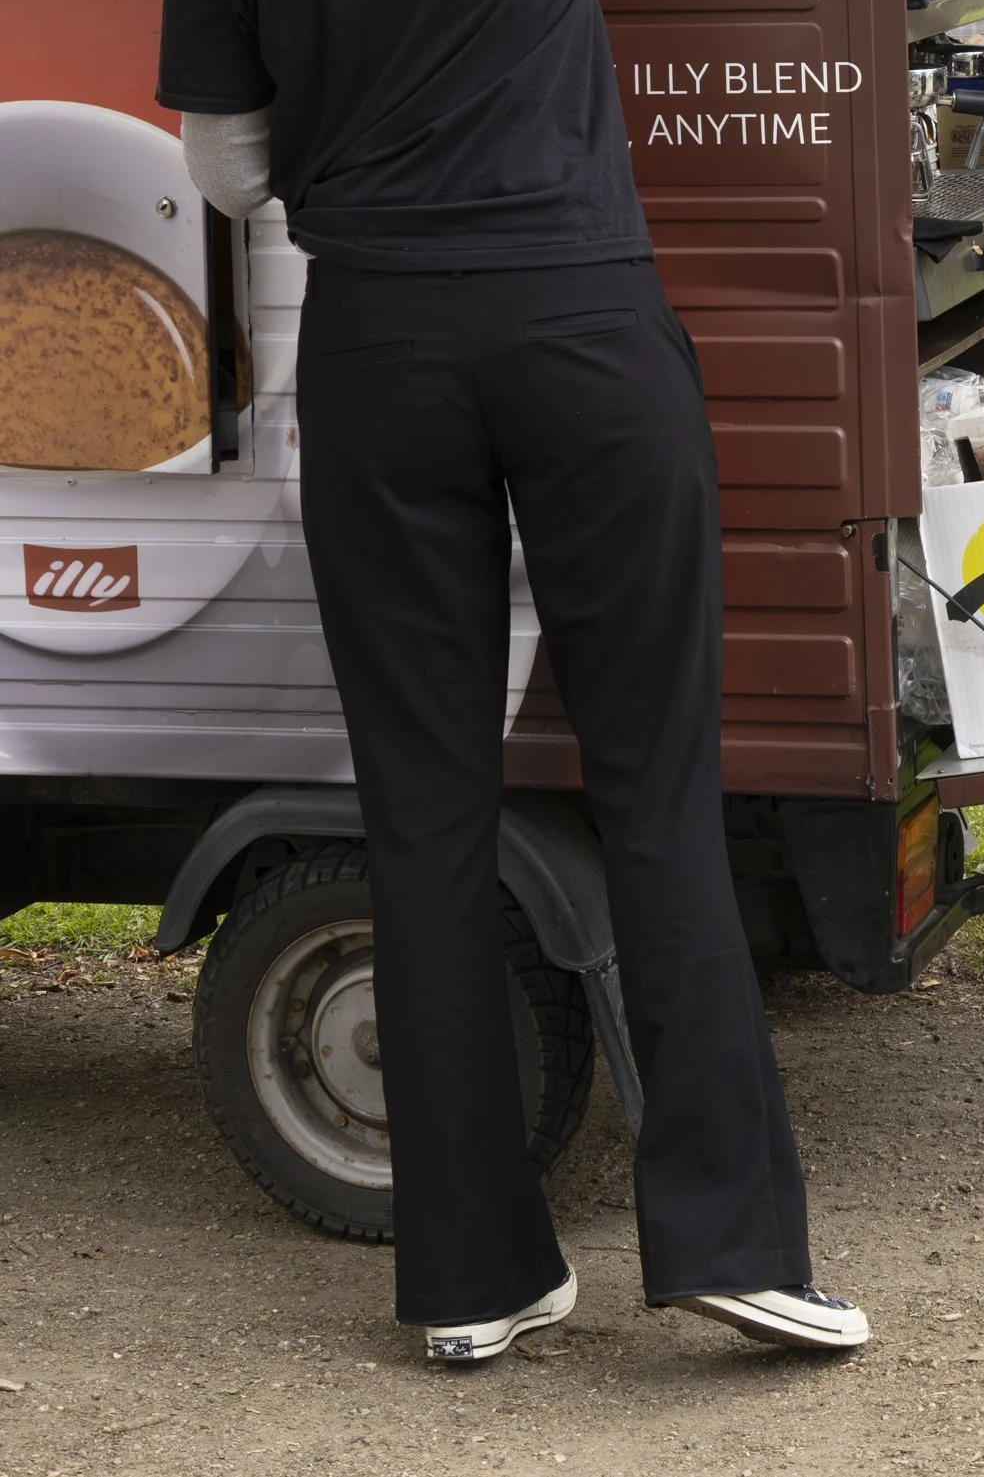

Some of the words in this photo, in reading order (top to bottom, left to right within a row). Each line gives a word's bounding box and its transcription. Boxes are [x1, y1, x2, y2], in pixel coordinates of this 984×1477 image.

[634, 63, 710, 96] ILLY
[725, 61, 863, 95] BLEND
[647, 112, 832, 146] ANYTIME
[33, 560, 131, 607] illy
